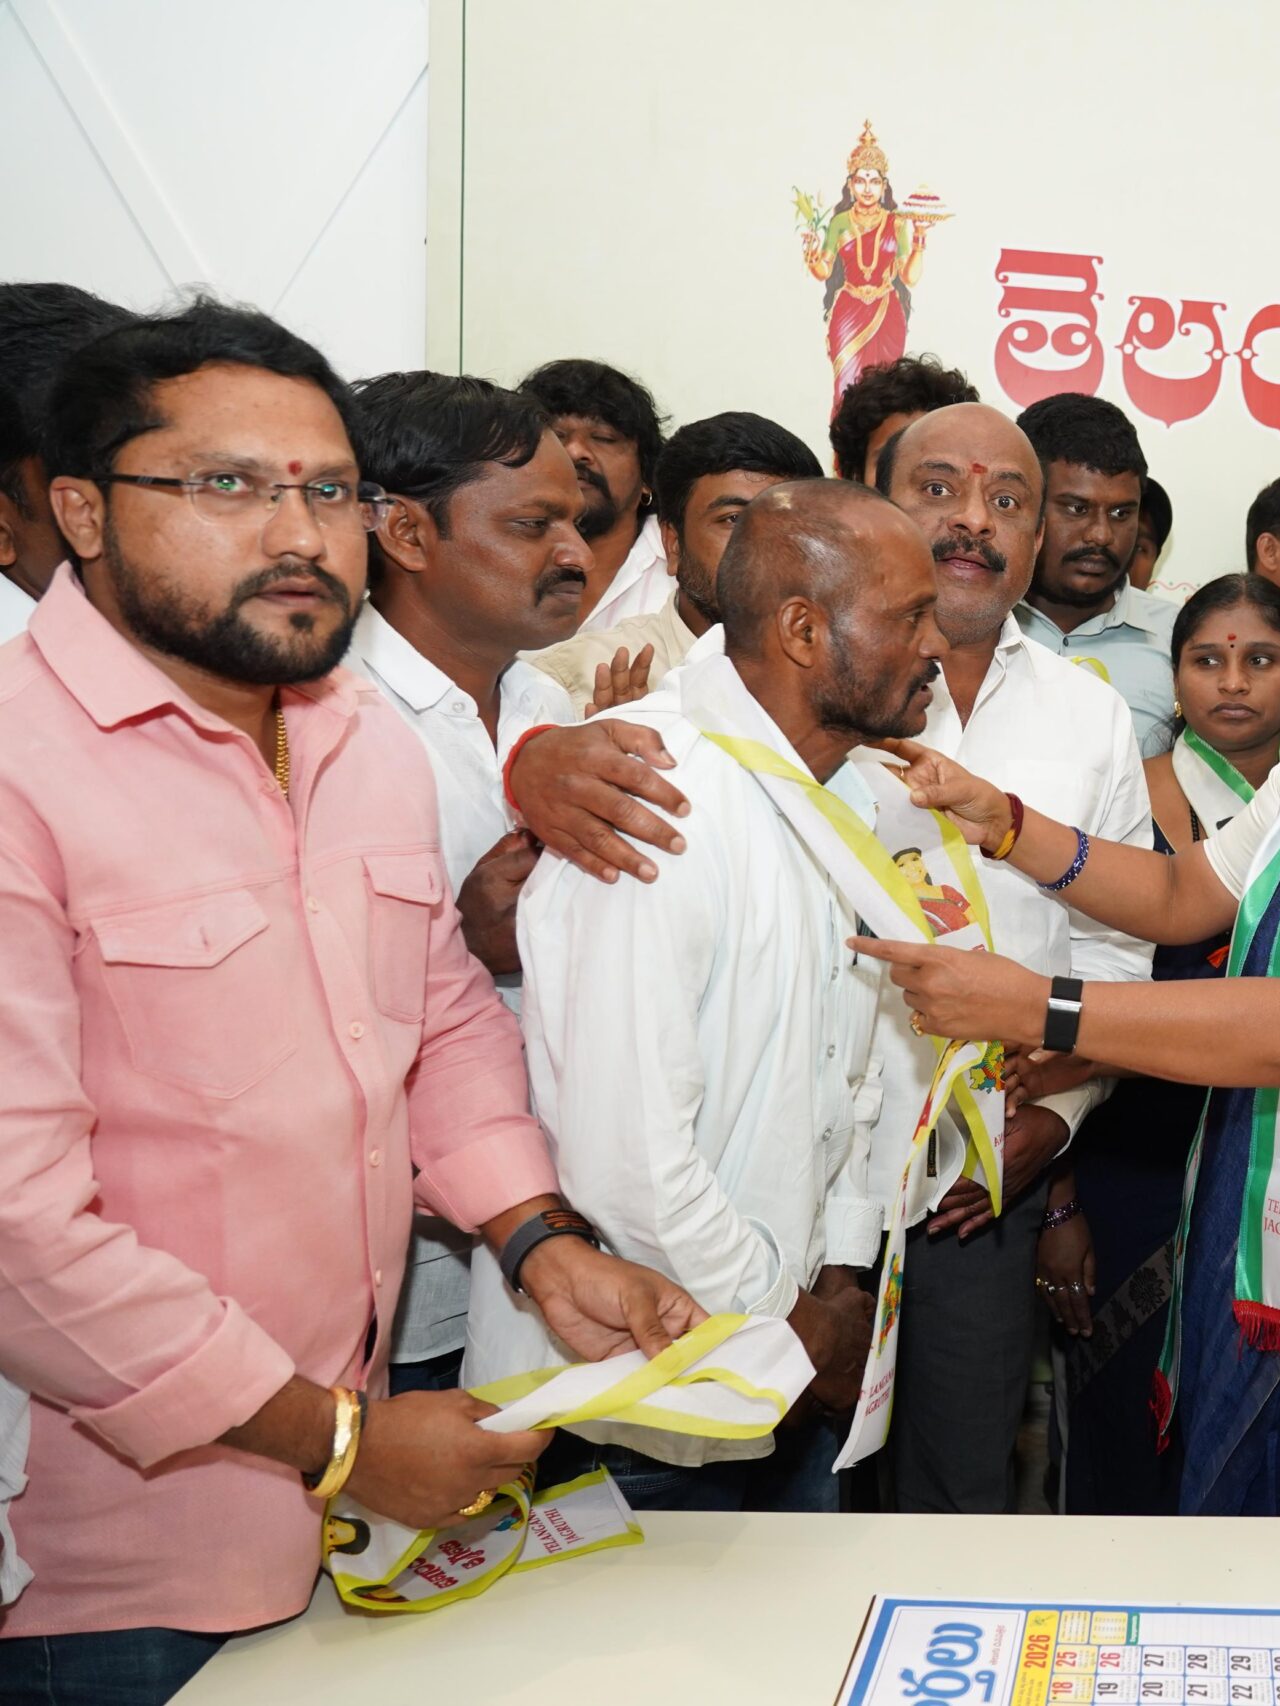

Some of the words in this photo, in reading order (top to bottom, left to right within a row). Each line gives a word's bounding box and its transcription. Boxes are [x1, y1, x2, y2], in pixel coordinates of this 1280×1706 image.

[528, 1508, 563, 1553] TELANGAN
[544, 1508, 584, 1544] JAGRUTHI
[1023, 1634, 1051, 1668] 2026
[1055, 1651, 1078, 1667] 25
[1100, 1652, 1121, 1668] 26
[1144, 1653, 1164, 1667] 27
[1187, 1654, 1208, 1669] 28
[1231, 1655, 1251, 1671] 29
[1051, 1682, 1073, 1695] 18
[1098, 1682, 1118, 1695] 19
[1142, 1682, 1163, 1697] 20
[1187, 1684, 1208, 1697] 21
[1232, 1684, 1253, 1700] 22
